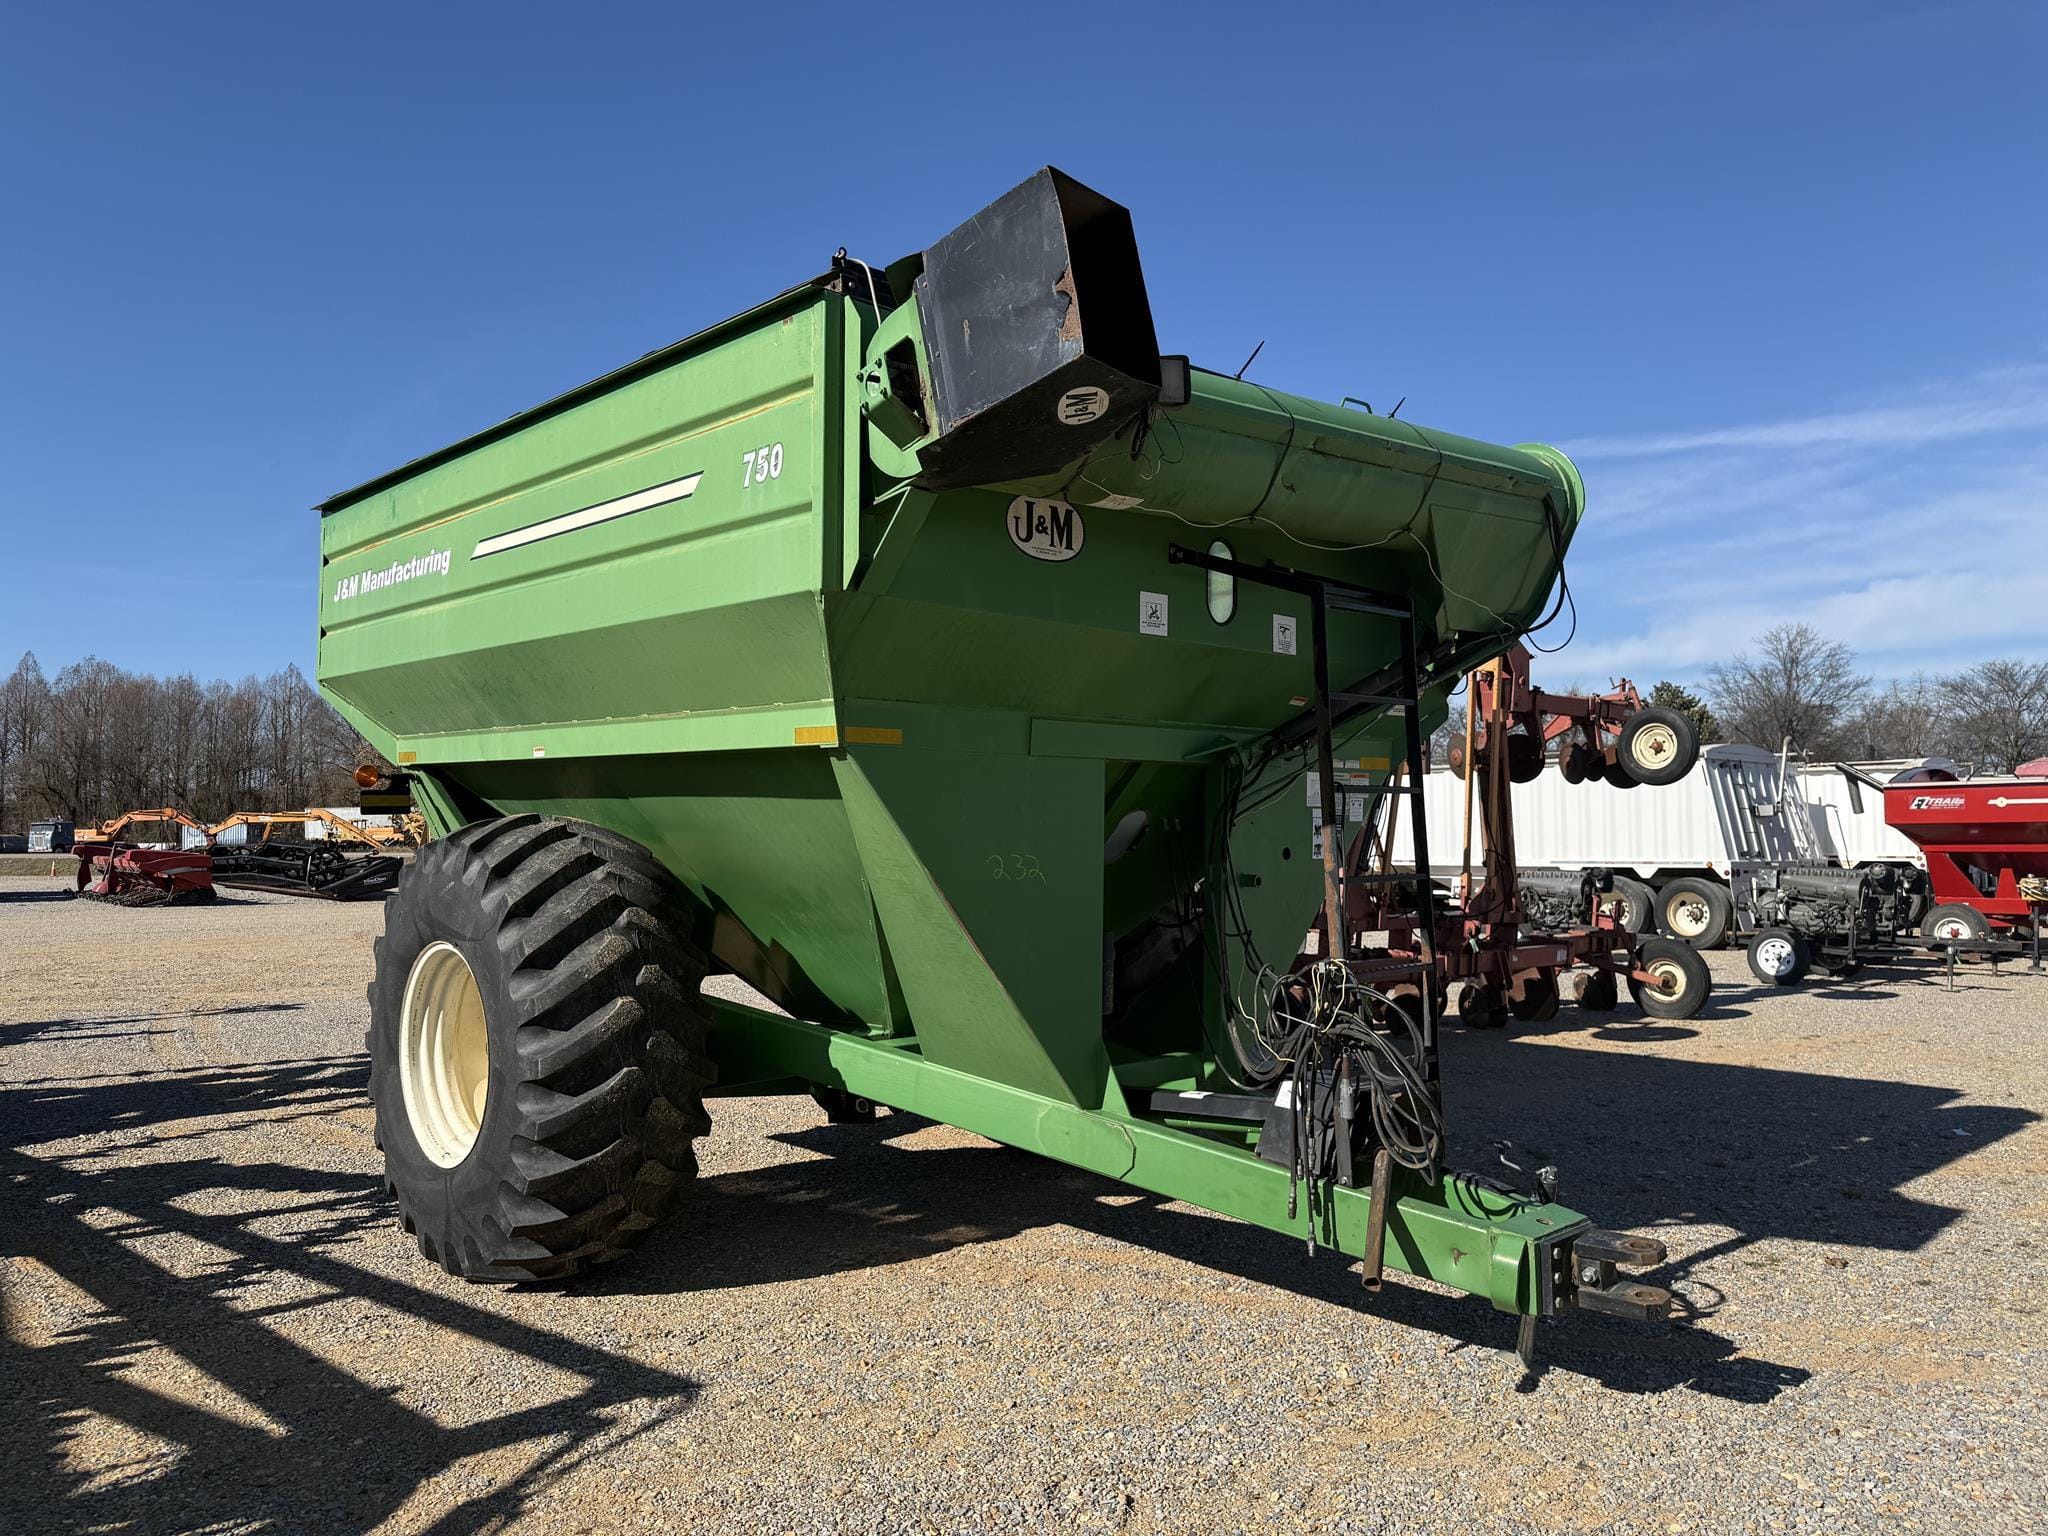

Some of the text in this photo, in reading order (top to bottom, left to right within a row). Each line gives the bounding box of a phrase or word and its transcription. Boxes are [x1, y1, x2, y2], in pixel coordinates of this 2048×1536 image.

[1065, 391, 1098, 422] J&M
[742, 441, 784, 490] 750
[1013, 499, 1075, 551] J&M
[333, 547, 452, 603] J&M Manufacturing
[986, 854, 1048, 888] 232
